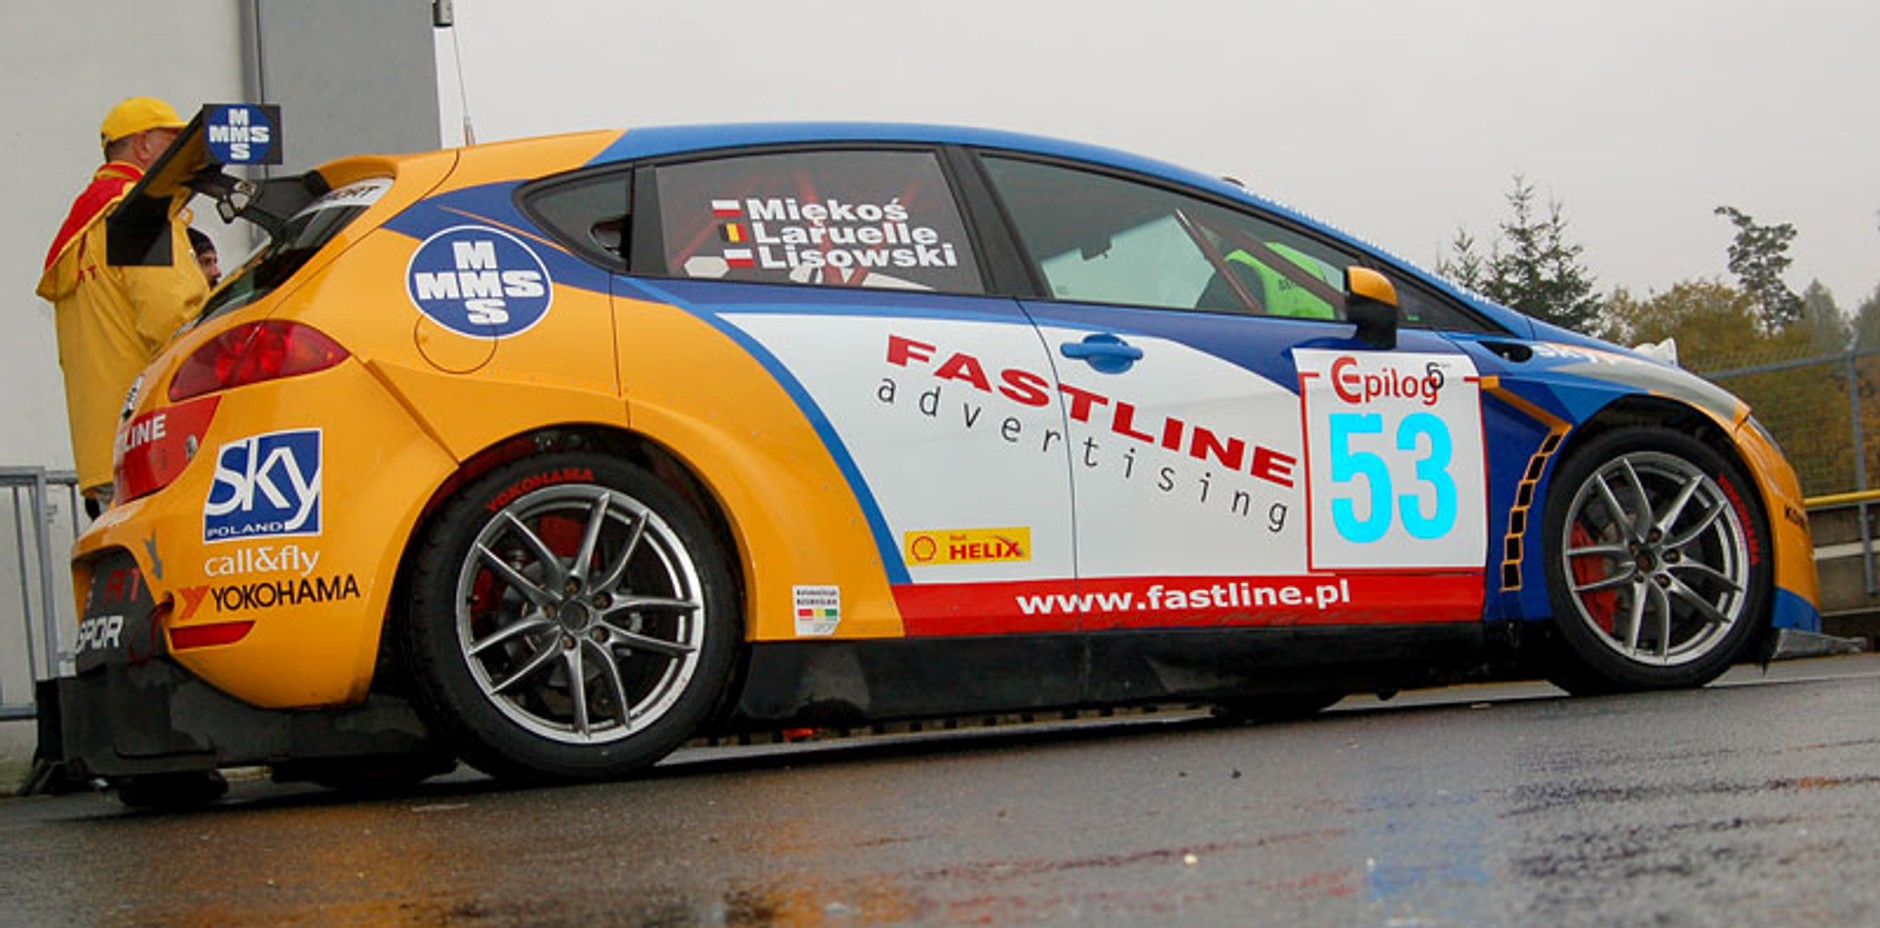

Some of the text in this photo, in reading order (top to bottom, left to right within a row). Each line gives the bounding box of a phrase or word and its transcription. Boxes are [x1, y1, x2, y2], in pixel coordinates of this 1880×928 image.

[746, 197, 908, 226] Miękoś
[752, 221, 938, 244] Laruelle
[759, 243, 957, 269] Lisowski
[1331, 356, 1438, 405] Epilog
[886, 335, 1297, 488] FASTLINE
[877, 377, 1288, 533] advertising
[486, 467, 594, 513] YOKOHAMA
[1329, 411, 1458, 543] 53
[207, 521, 283, 537] POLAND
[204, 545, 320, 577] call&fly
[949, 542, 1020, 560] HELIX
[212, 573, 360, 612] YOKOHAMA
[1016, 579, 1350, 614] www.fastline.pl
